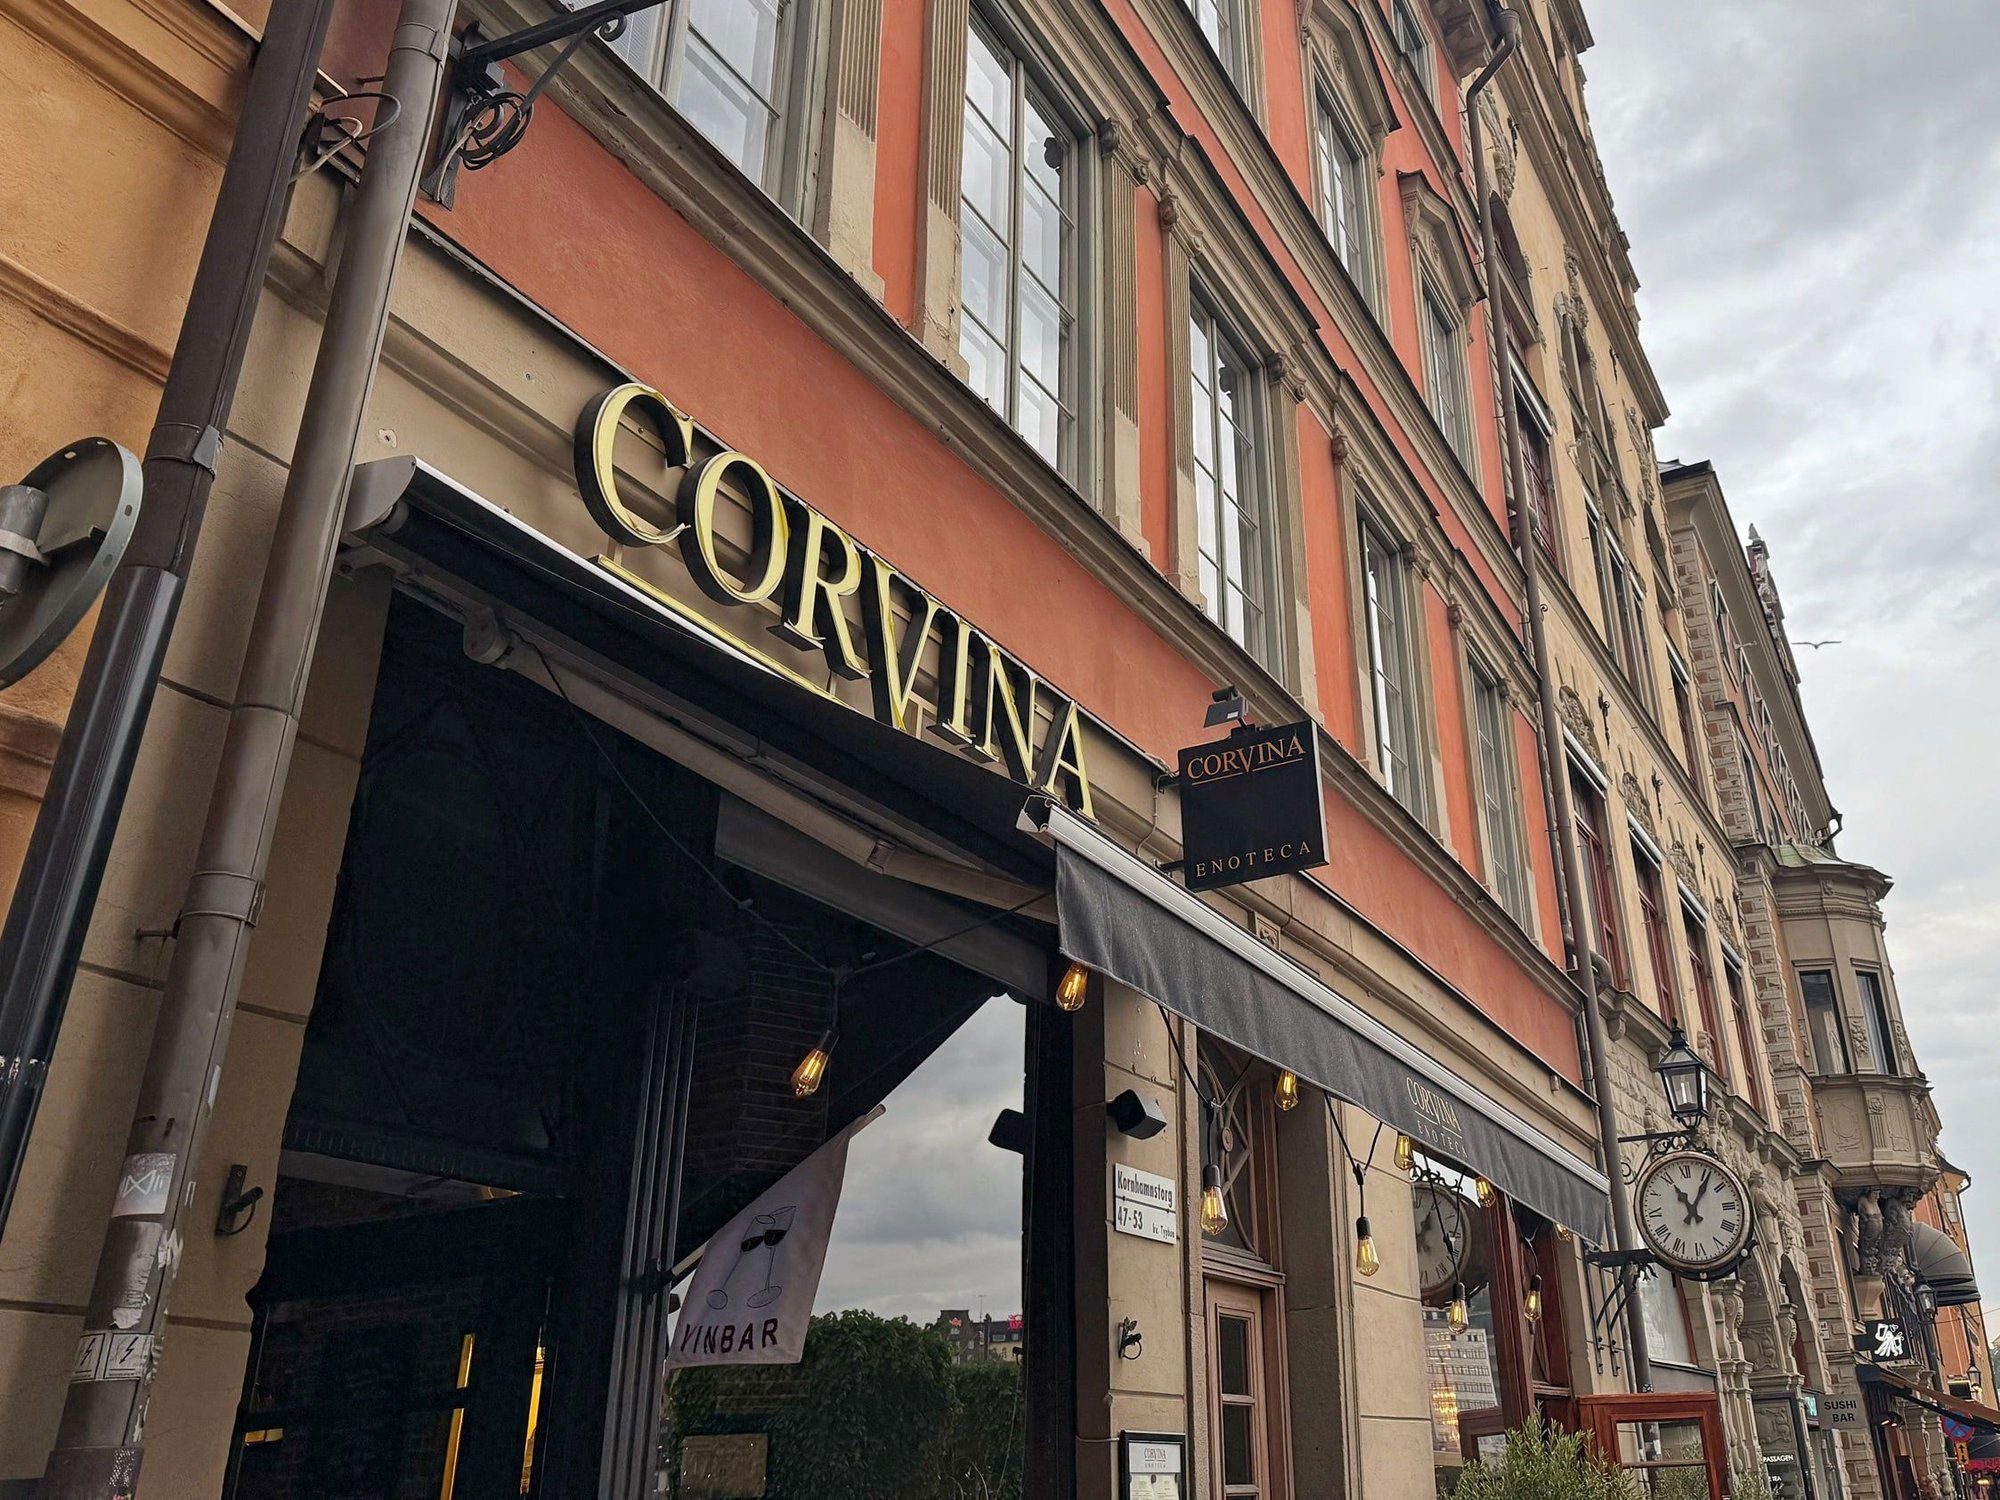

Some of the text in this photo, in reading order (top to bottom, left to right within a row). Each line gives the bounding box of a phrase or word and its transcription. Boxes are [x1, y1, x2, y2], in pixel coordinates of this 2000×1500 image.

[574, 383, 1098, 824] CORVINA
[1187, 735, 1306, 779] CORVINA
[1196, 841, 1311, 878] ENOTECA
[1406, 1077, 1462, 1132] CORVINA
[1117, 1170, 1173, 1208] Kornhamnstorg
[1721, 1201, 1736, 1211] III
[1117, 1206, 1143, 1230] 47-53
[680, 1318, 778, 1354] VINBAR
[1823, 1400, 1857, 1411] SUSHI
[1832, 1412, 1856, 1423] BAR
